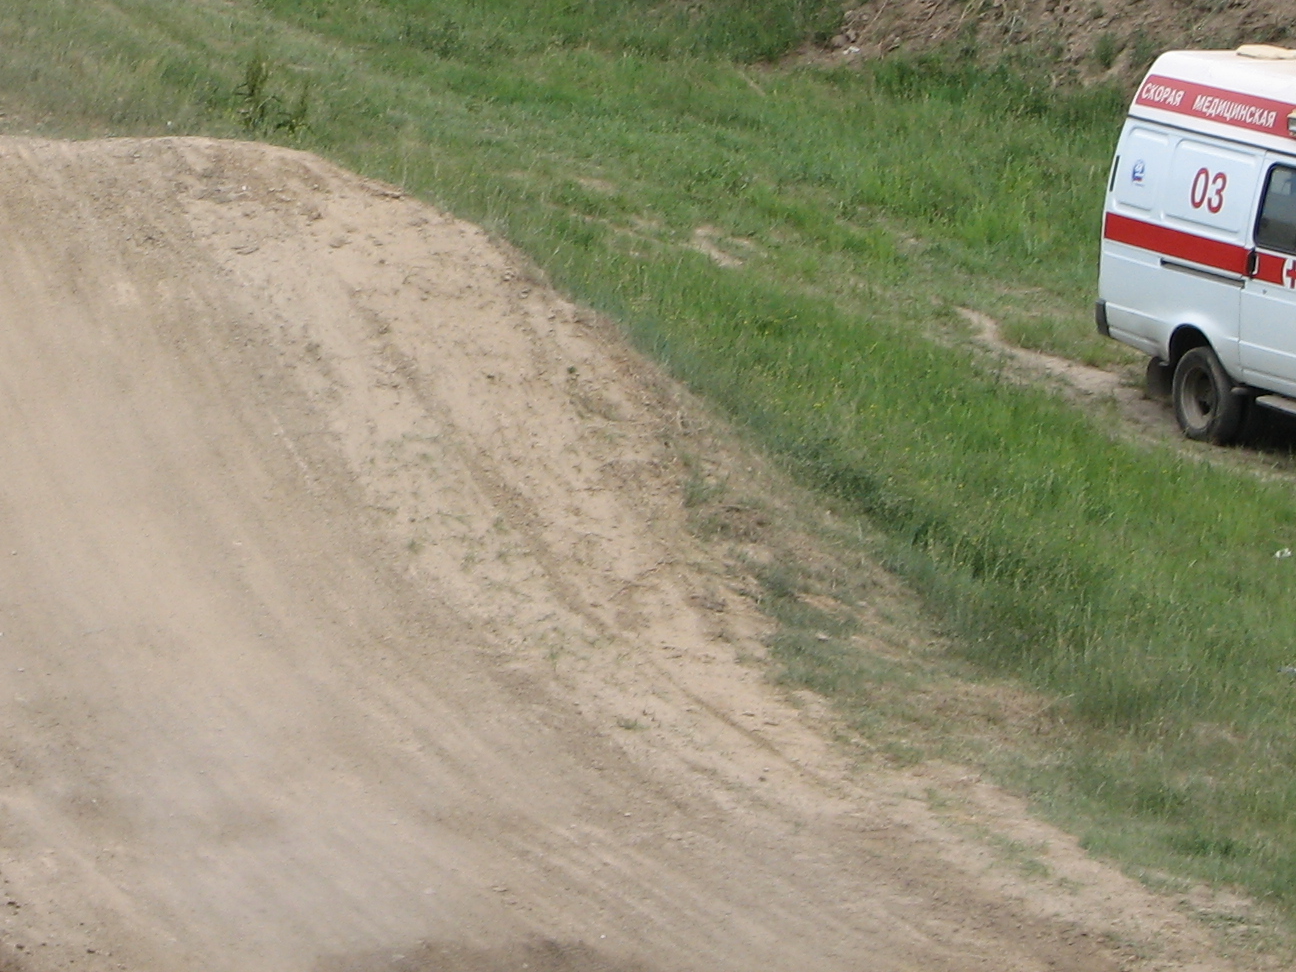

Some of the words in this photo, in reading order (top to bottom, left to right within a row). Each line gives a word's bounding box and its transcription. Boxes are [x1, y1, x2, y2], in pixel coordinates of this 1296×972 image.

[1141, 83, 1185, 106] СКОРАЯ
[1192, 95, 1277, 128] МЕДИЦИНСКАЯ
[1190, 167, 1227, 213] 03
